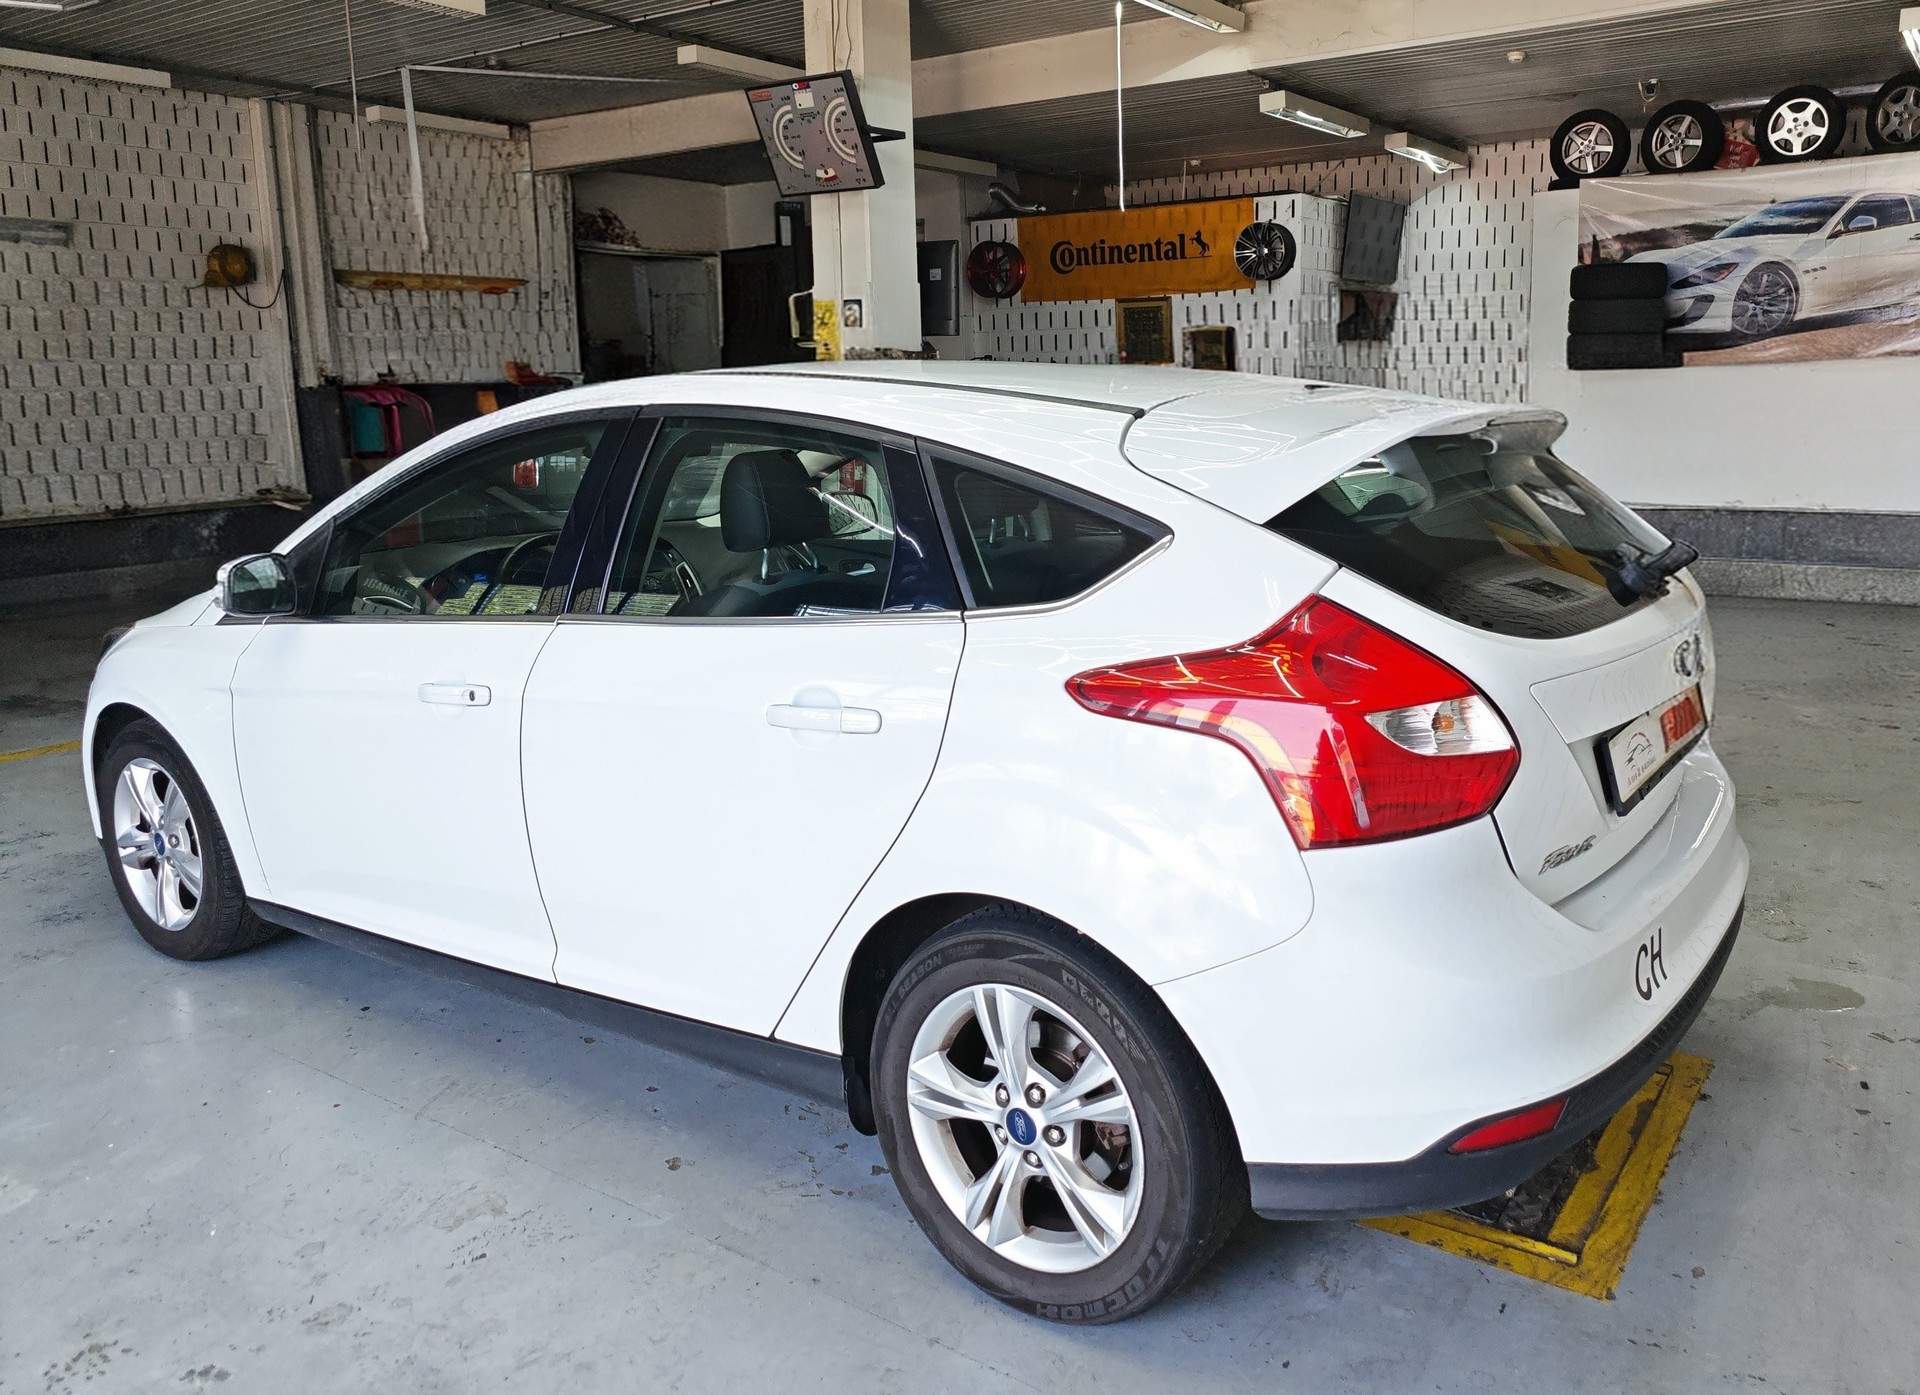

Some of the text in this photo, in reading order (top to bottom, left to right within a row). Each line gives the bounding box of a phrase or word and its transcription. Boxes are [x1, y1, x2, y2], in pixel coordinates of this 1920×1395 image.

[1050, 233, 1188, 275] Continental
[898, 953, 943, 1000] SEASON
[1635, 926, 1668, 1001] CH
